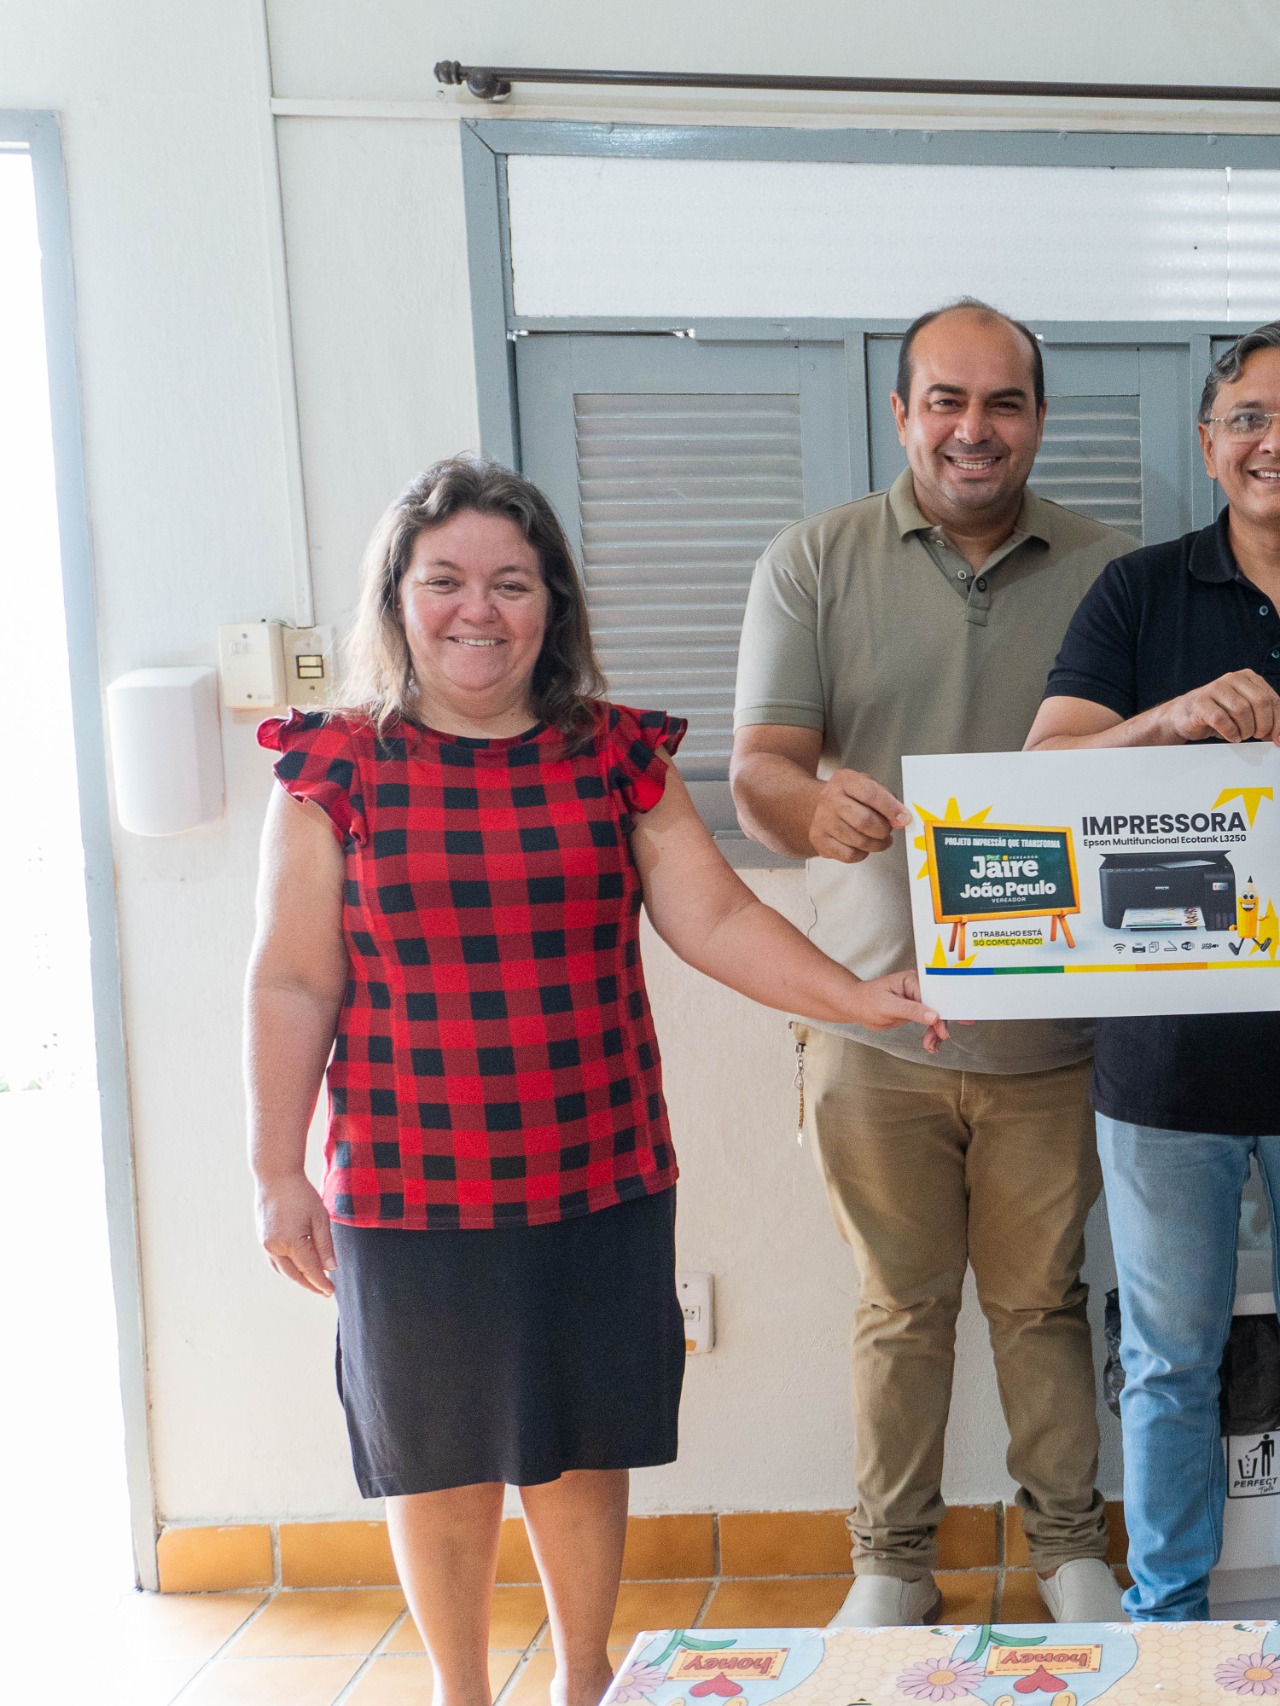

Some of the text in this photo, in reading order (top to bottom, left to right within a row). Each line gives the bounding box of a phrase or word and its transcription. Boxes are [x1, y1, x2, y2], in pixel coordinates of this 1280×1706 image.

[1082, 812, 1247, 836] IMPRESSORA
[944, 836, 1061, 849] PROJETO IMPRESSÃO QUE TRANSFORMA
[1083, 834, 1247, 849] Epson Multifuncional Ecotank L3250
[969, 855, 1039, 879] Jaire
[960, 880, 1057, 898] João Paulo
[1022, 928, 1043, 937] ESTÁ
[985, 938, 1043, 947] COMEÇANDO!
[1233, 1477, 1278, 1488] PERFECT
[683, 1655, 773, 1675] honey
[1000, 1650, 1088, 1667] honey
